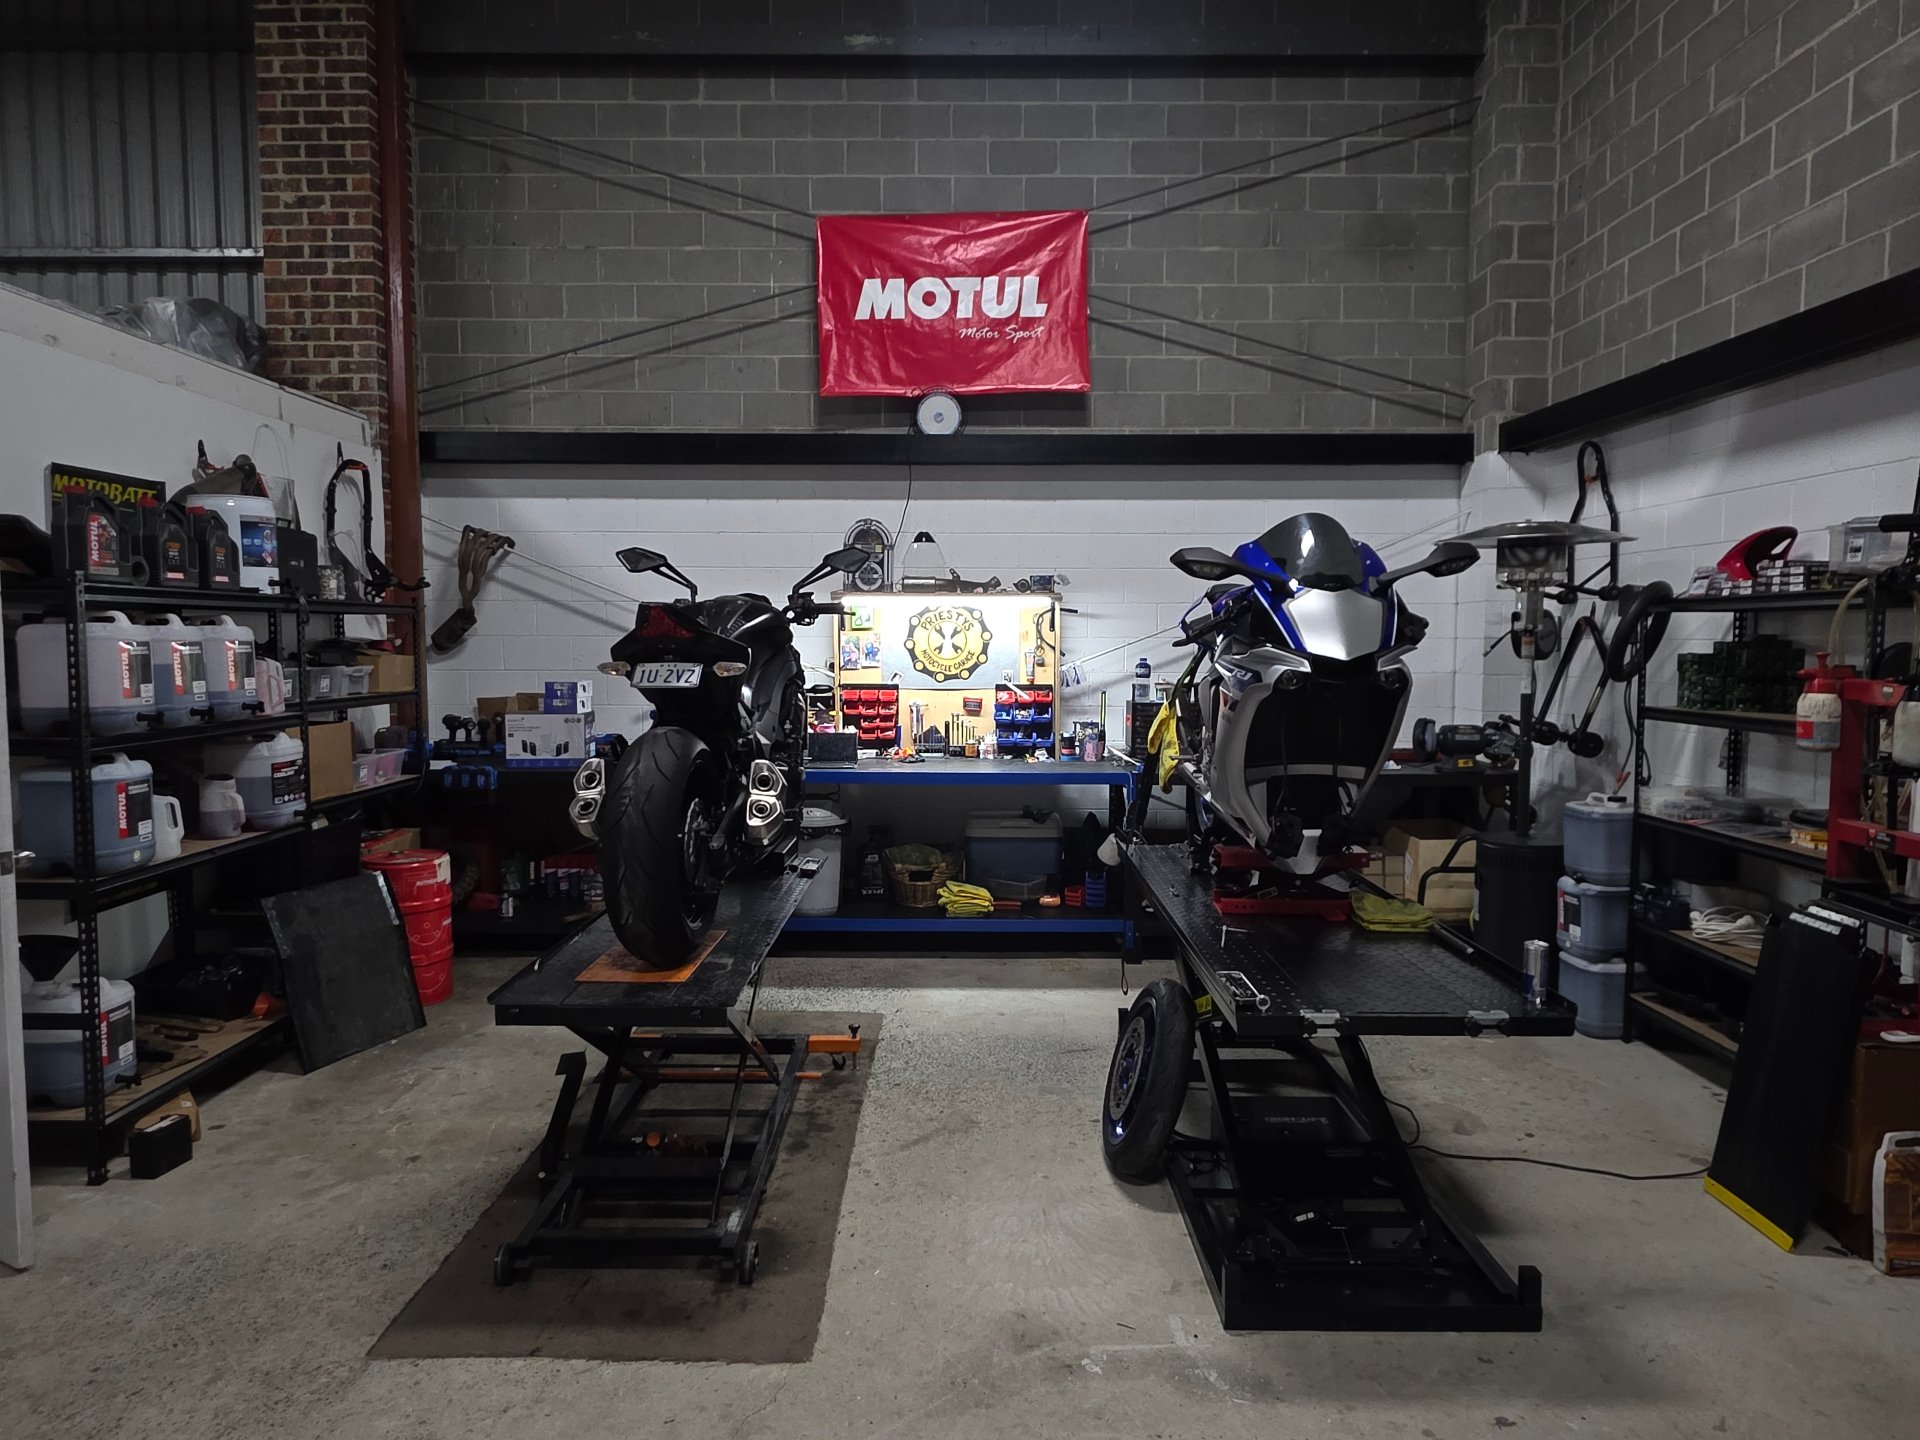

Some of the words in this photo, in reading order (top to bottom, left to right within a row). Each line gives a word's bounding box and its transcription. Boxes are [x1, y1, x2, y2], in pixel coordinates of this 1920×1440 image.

[855, 276, 1048, 320] MOTUL
[959, 326, 1000, 339] Motor
[1005, 324, 1045, 343] Sport
[90, 520, 100, 562] MOTUL
[121, 652, 131, 689] MOTUL
[173, 651, 183, 686] MOTUL
[227, 649, 236, 682] MOTUL
[118, 792, 128, 829] MOTUL
